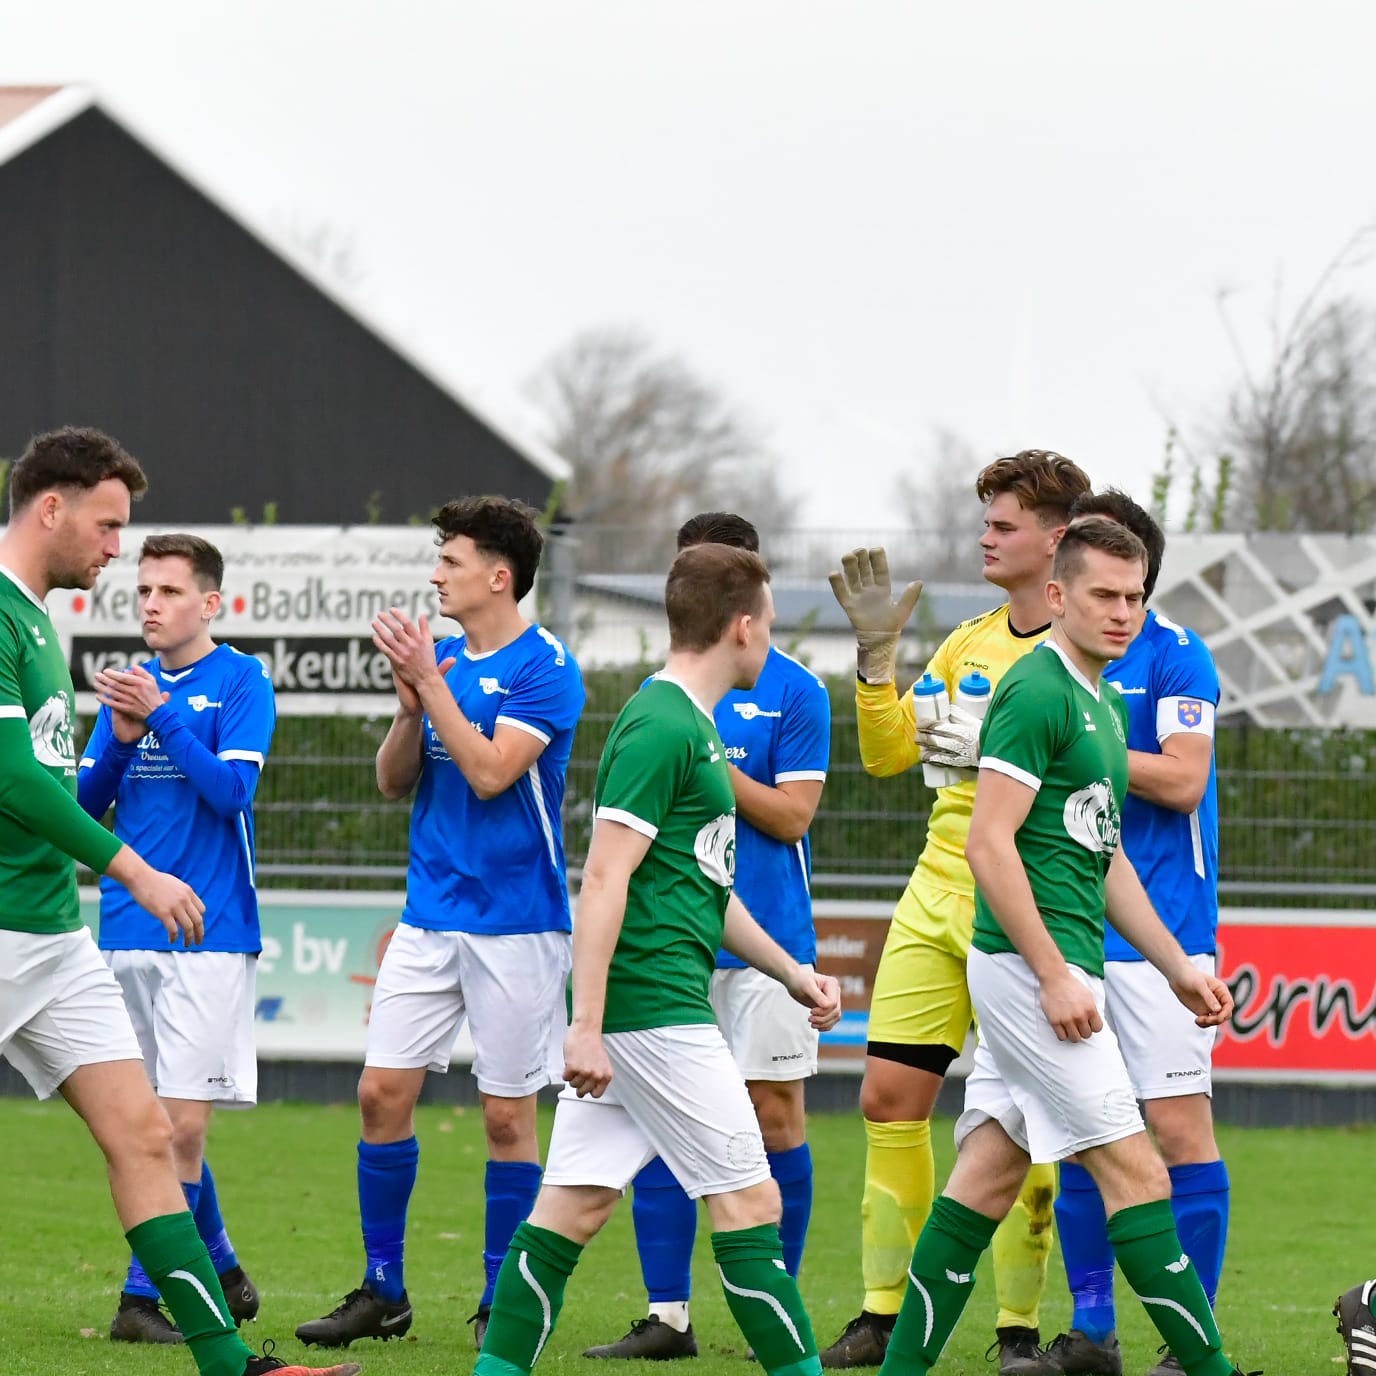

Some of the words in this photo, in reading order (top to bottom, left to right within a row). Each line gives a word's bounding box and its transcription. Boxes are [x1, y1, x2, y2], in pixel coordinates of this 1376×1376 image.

[251, 575, 438, 623] Badkamers
[292, 922, 349, 974] bv
[1166, 1069, 1201, 1078] STANNO
